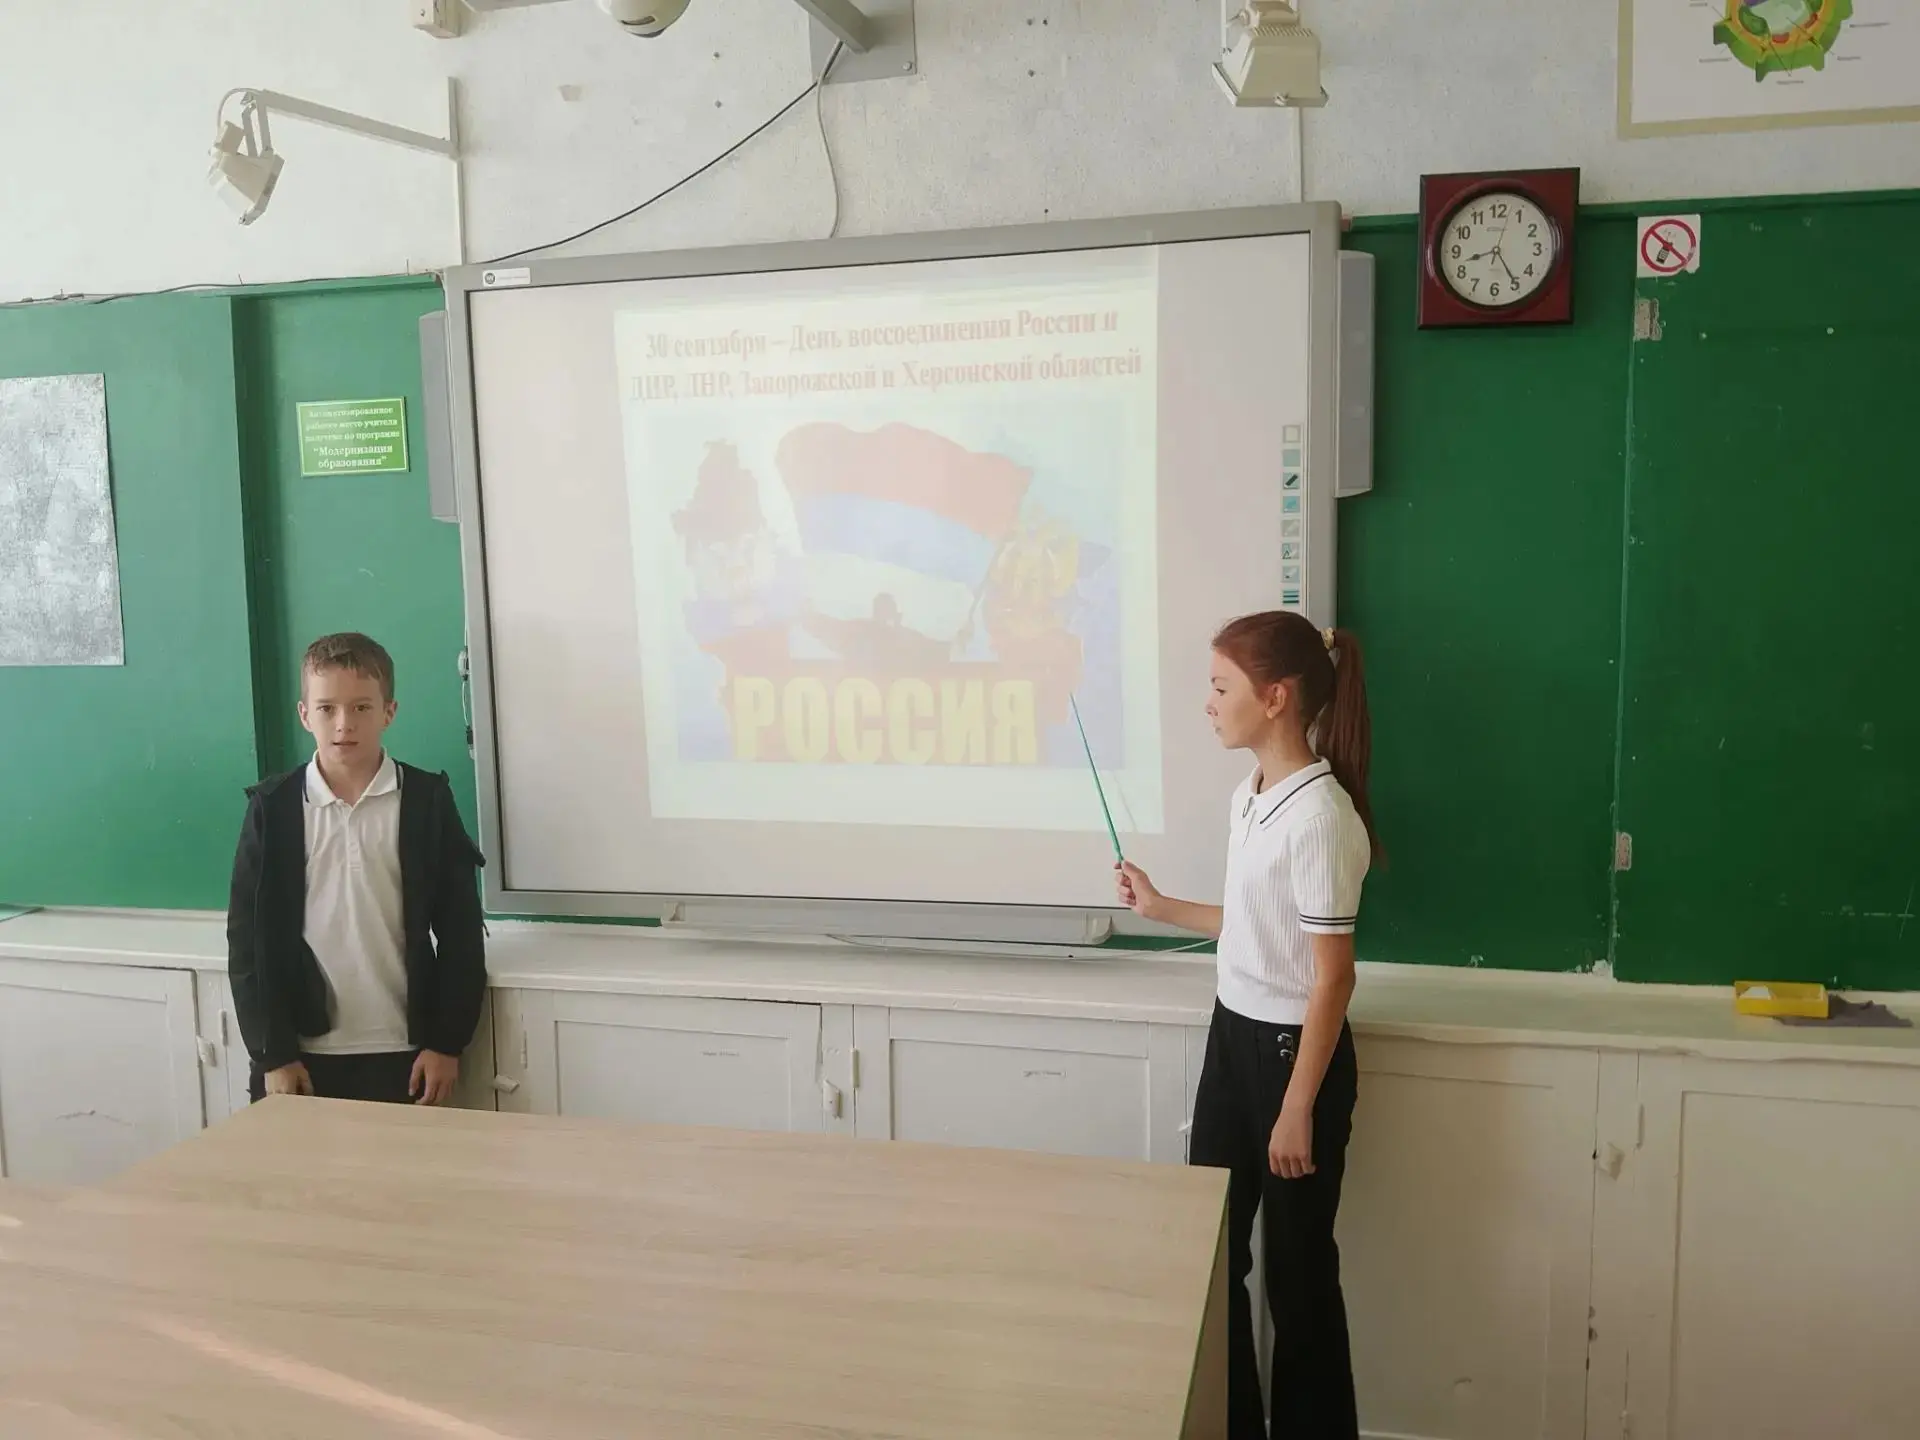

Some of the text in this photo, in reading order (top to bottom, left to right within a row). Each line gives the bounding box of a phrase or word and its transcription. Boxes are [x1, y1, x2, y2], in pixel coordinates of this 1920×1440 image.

[1471, 210, 1484, 225] 11
[1489, 204, 1507, 218] 12
[1516, 209, 1522, 223] 1
[1456, 225, 1470, 240] 10
[1528, 224, 1537, 237] 2
[1451, 245, 1461, 259] 9
[1533, 242, 1542, 256] 3
[1457, 265, 1466, 279] 8
[1524, 263, 1533, 277] 4
[1471, 278, 1480, 292] 7
[1490, 282, 1499, 296] 6
[1510, 277, 1520, 291] 5
[646, 333, 667, 358] 30
[674, 329, 766, 360] сентября
[790, 325, 842, 355] День
[849, 317, 1011, 346] воссоединения
[1017, 310, 1097, 337] России
[1103, 310, 1118, 332] и
[740, 364, 876, 398] Запорожской
[882, 368, 895, 388] и
[902, 355, 1032, 392] Херсонской
[1040, 348, 1141, 379] областей
[733, 675, 1038, 764] РОССИЯ
